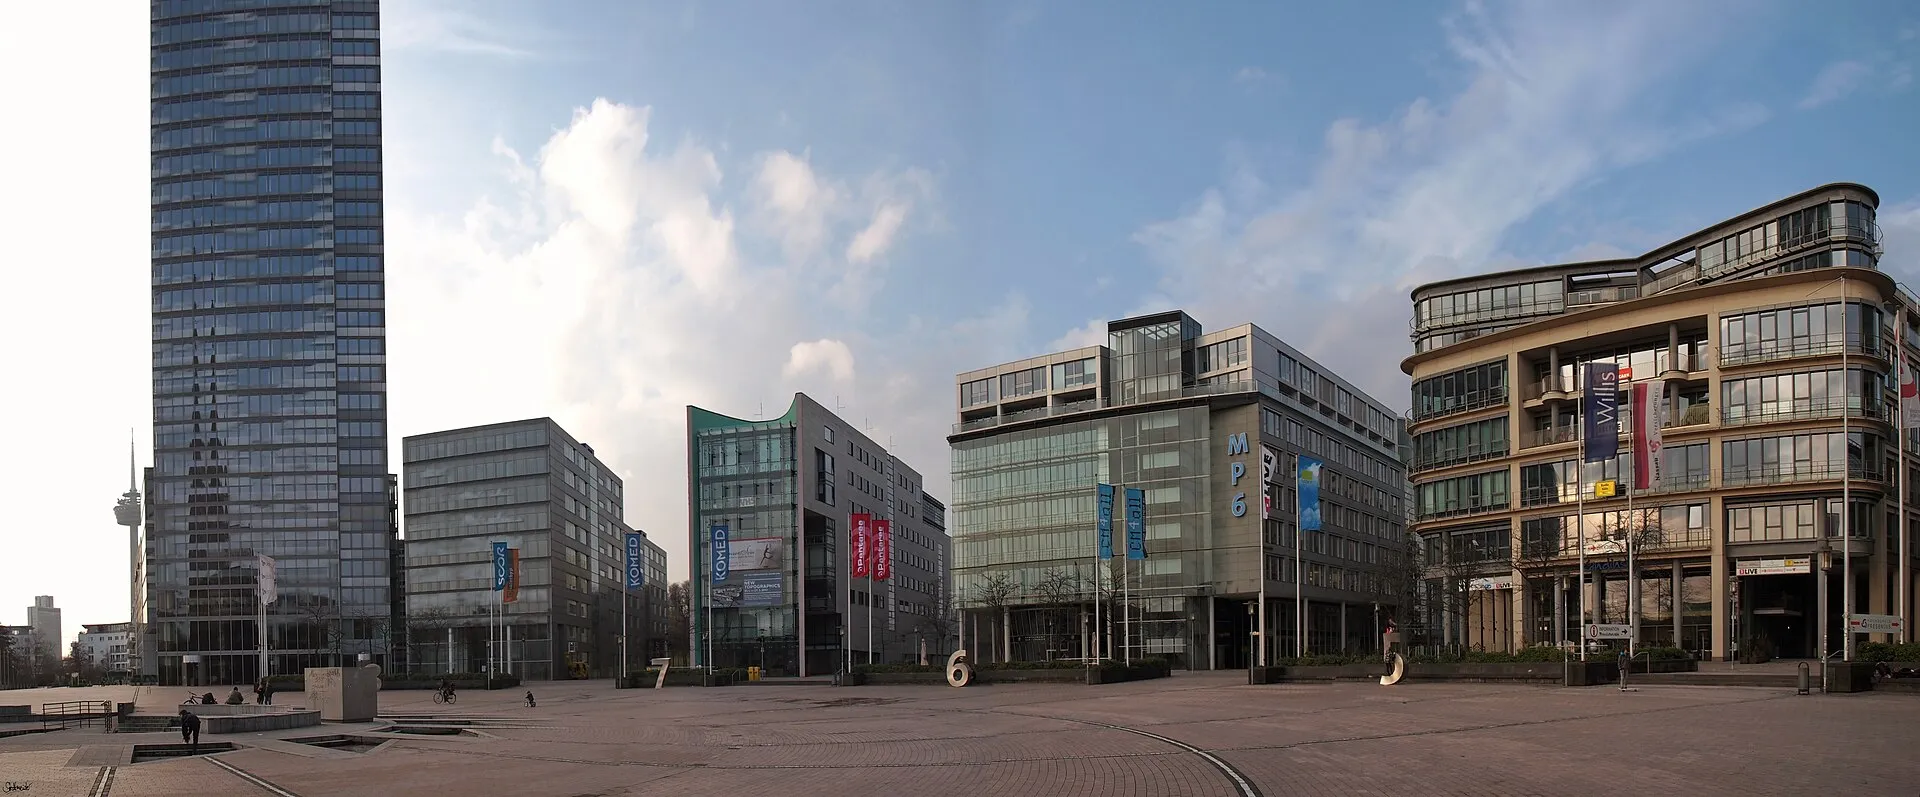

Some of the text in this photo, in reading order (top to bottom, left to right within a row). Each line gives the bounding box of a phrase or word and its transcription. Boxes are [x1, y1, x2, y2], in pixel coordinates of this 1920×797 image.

[1593, 372, 1615, 425] Willis
[1227, 432, 1248, 517] MP6
[1100, 494, 1112, 548] CM4all
[1128, 498, 1142, 551] CM4all
[629, 537, 641, 587] KOMED
[715, 529, 726, 581] KOMED
[651, 658, 671, 689] 7
[946, 649, 970, 688] 6
